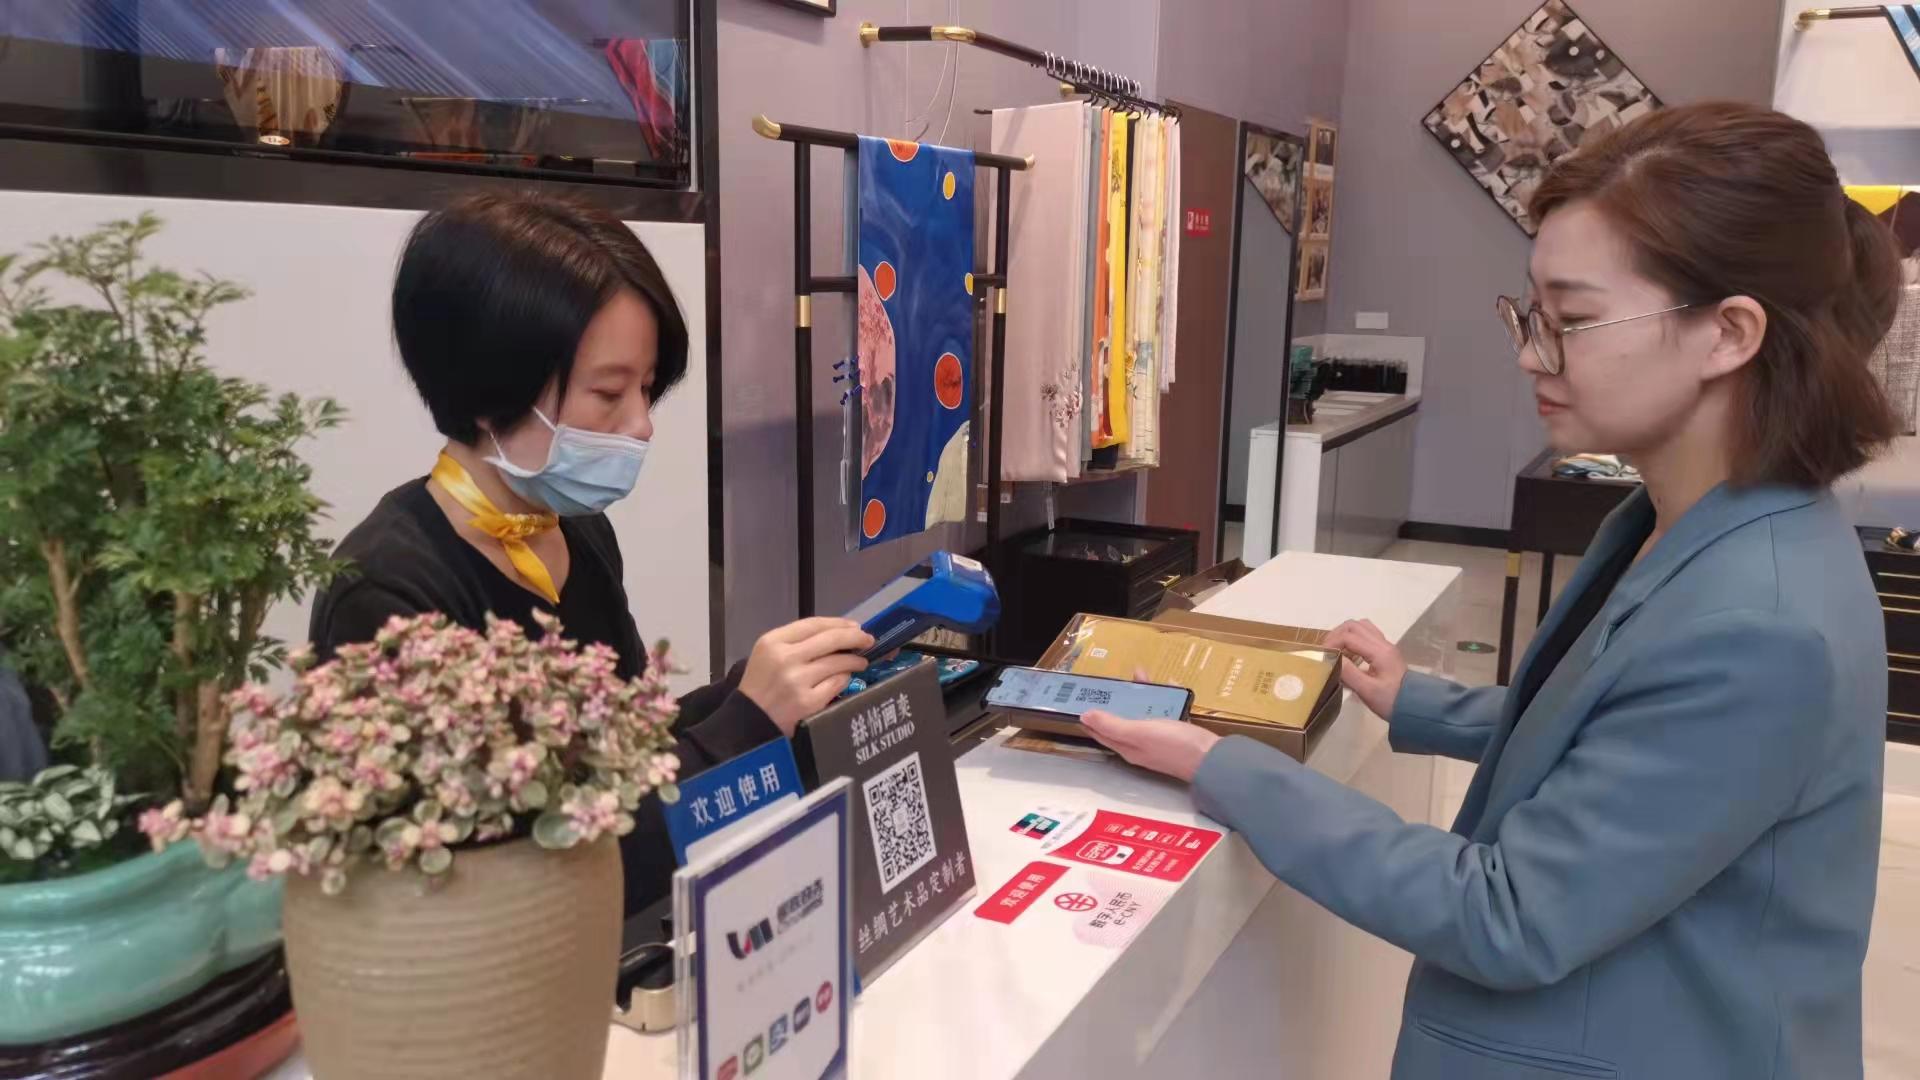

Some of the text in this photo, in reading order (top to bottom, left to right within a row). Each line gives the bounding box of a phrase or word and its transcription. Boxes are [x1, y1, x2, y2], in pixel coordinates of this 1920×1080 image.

[856, 720, 915, 765] SILK STUDIO
[690, 763, 780, 828] 欢迎使用
[1089, 892, 1133, 928] 数字人民币
[1113, 901, 1142, 926] e-CNY
